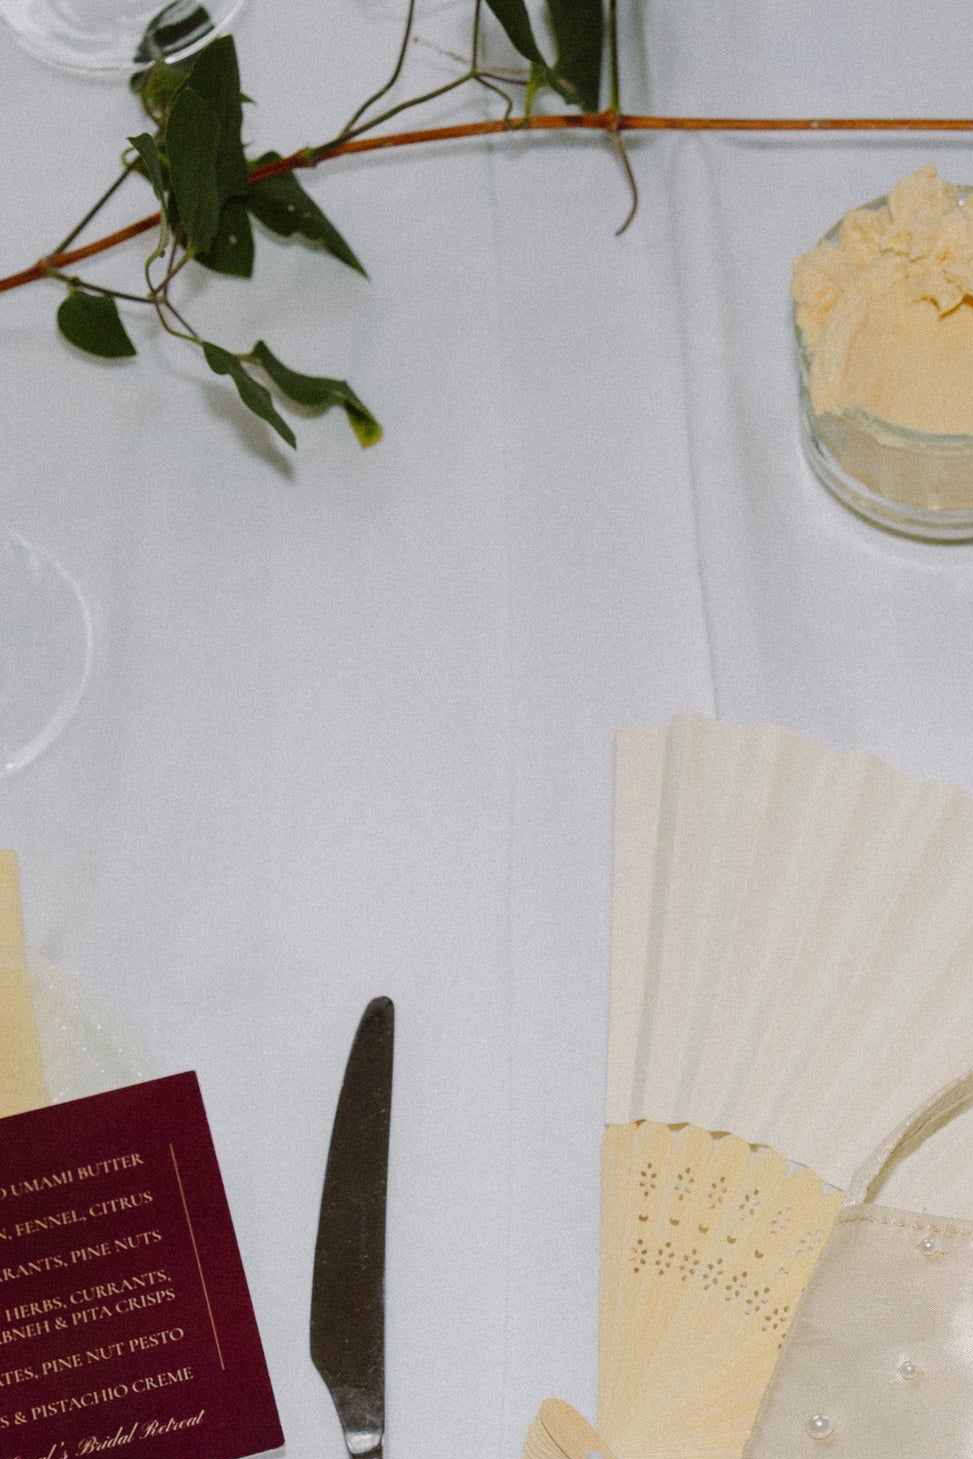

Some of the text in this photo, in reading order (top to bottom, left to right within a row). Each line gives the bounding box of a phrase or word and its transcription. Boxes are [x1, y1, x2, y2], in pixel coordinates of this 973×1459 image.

[11, 1170, 74, 1197] UMAMI
[77, 1153, 144, 1180] BUTTER
[16, 1210, 87, 1237] FENNEL,
[88, 1191, 153, 1217] CITRUS
[0, 1230, 162, 1282] RANTS, PINE NUTS
[0, 1288, 176, 1345] BNEH & PITA CRISPS
[5, 1269, 172, 1322] HERBS, CURRANTS,
[42, 1353, 83, 1375] PINE
[86, 1342, 125, 1363] NUT
[129, 1327, 185, 1352] PESTO
[14, 1411, 28, 1425] &
[31, 1384, 129, 1420] PISTACHIO
[132, 1366, 194, 1394] CREME
[75, 1422, 139, 1457] Bridal
[139, 1409, 205, 1439] Retreat
